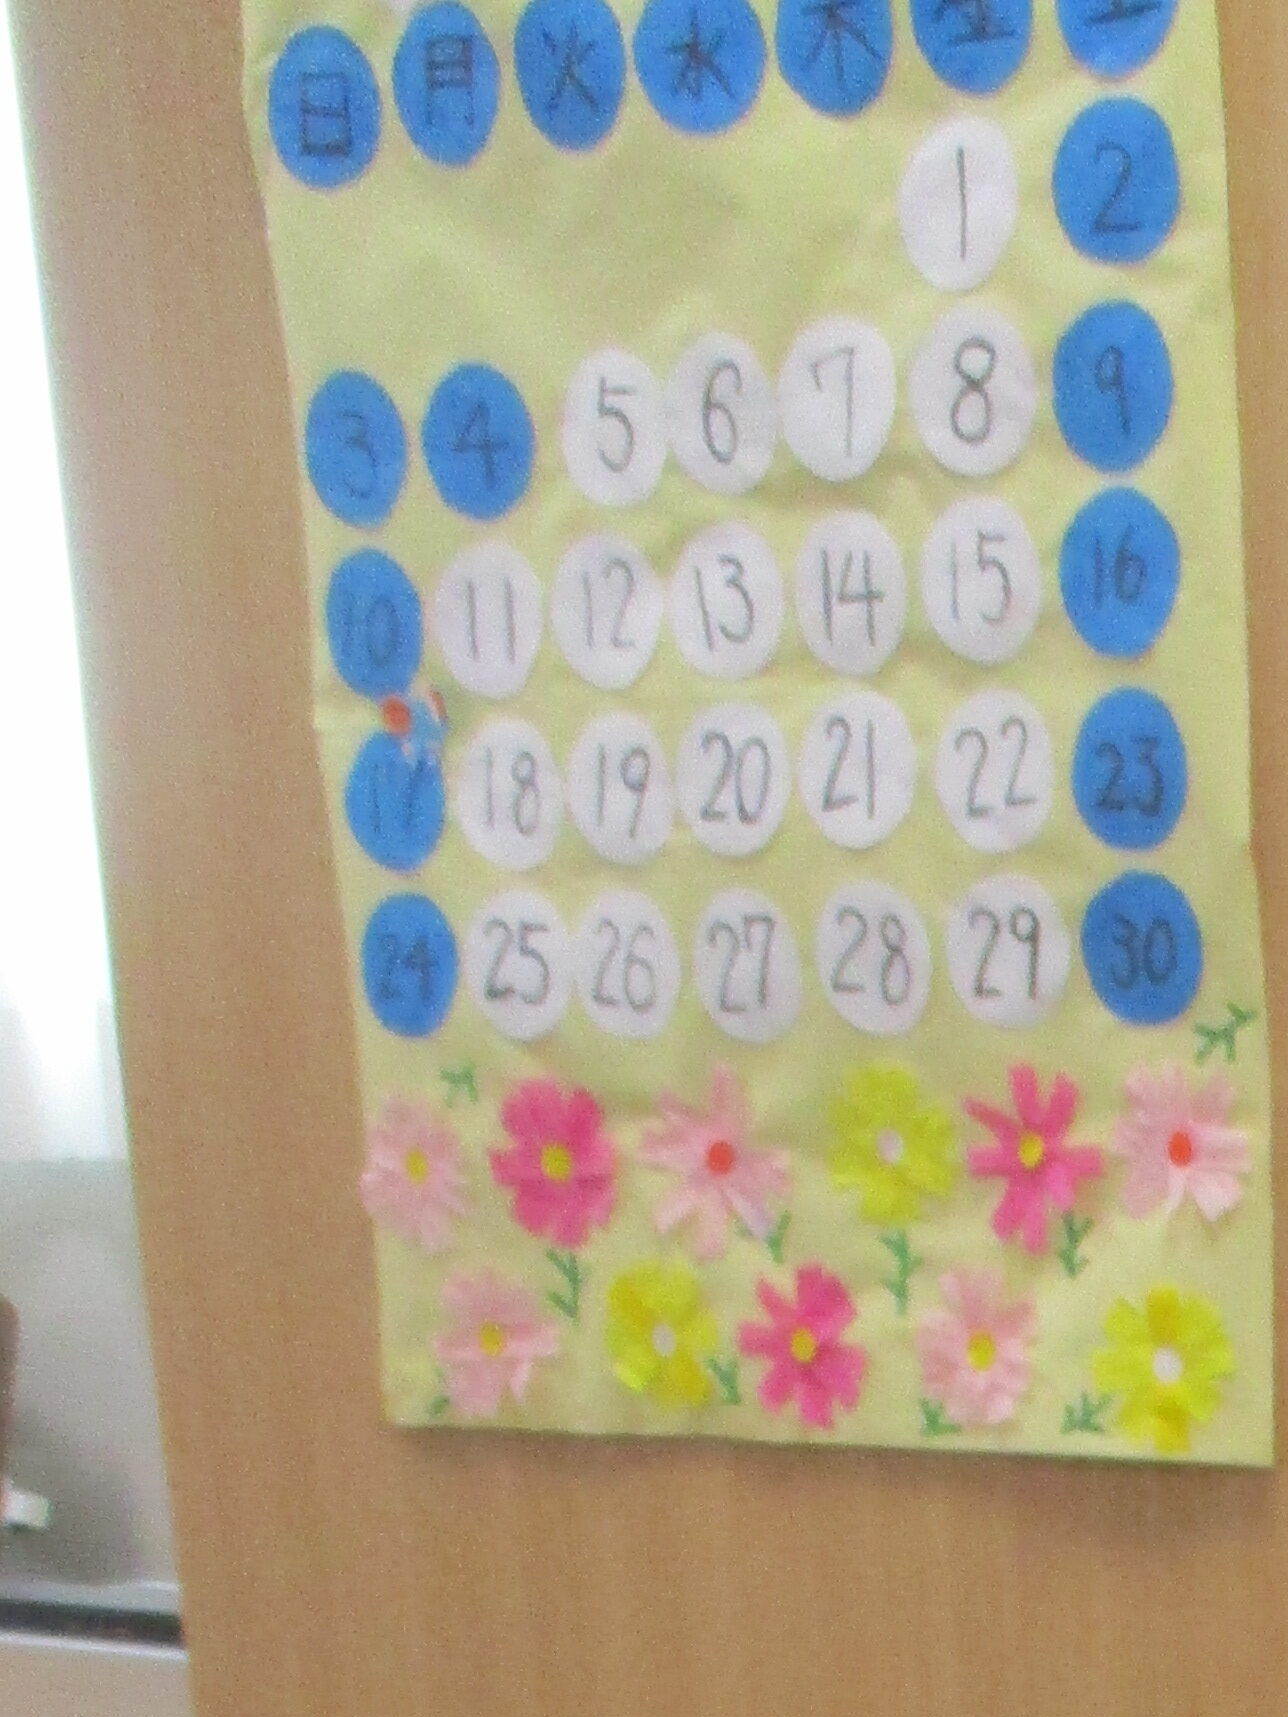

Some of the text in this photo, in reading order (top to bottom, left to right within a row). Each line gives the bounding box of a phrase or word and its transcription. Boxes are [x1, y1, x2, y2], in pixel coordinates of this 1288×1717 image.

[302, 72, 351, 157] 日
[426, 35, 475, 127] 月
[542, 18, 598, 110] 火
[667, 8, 737, 98] 水
[955, 140, 1142, 262] 1 2
[340, 336, 1131, 499] 3 4 5 6 7 8 9
[340, 523, 1148, 667] 10 11 12 13 14 15 16
[483, 745, 541, 836] 18
[598, 742, 651, 839] 19
[700, 728, 772, 825] 20
[821, 714, 877, 820] 21
[955, 714, 1038, 819] 22
[1094, 735, 1164, 819] 23
[377, 905, 1178, 1014] 24 25 26 27 28 29 30
